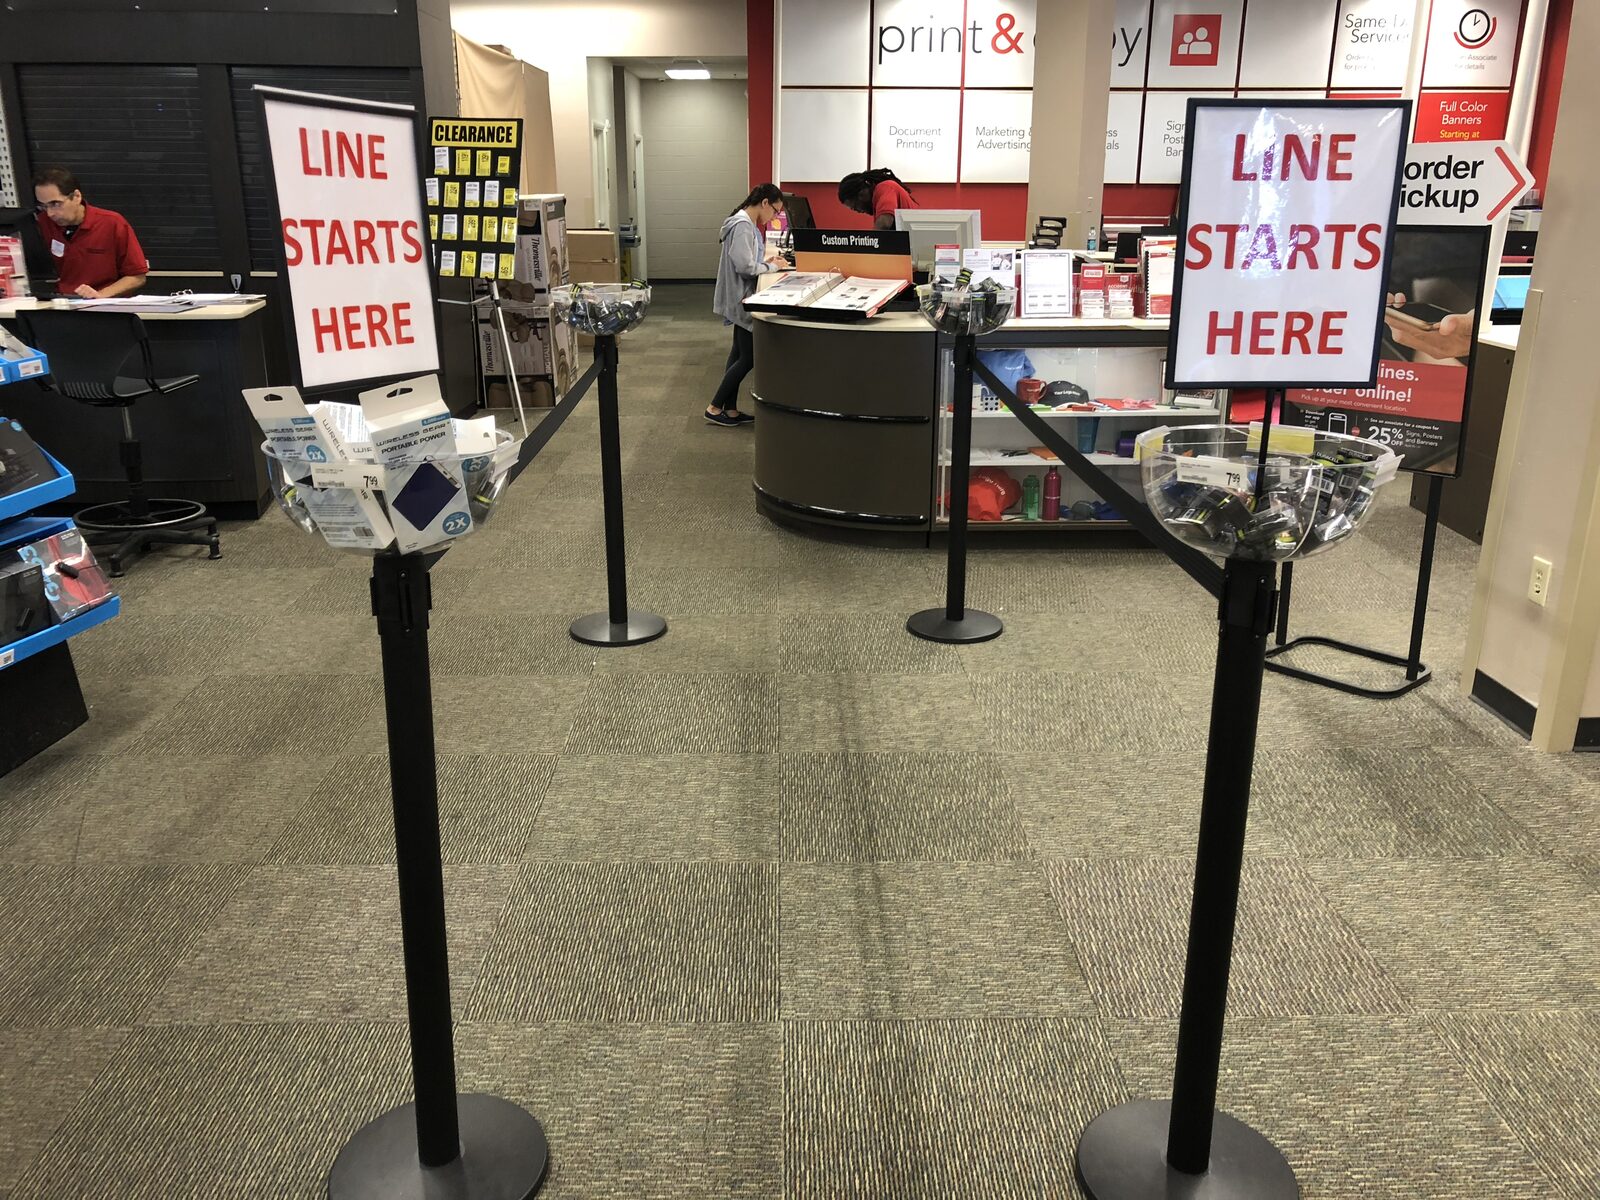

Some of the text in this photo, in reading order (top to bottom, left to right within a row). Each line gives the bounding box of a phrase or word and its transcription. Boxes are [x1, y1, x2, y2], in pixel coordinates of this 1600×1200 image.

[1345, 13, 1387, 28] Same
[878, 12, 1025, 65] print &
[1439, 101, 1488, 112] Full Color
[1441, 114, 1482, 126] Banners
[434, 124, 513, 144] CLEARANCE
[889, 125, 942, 136] Document
[975, 126, 1025, 139] Marketing
[1163, 133, 1185, 144] Post
[1439, 129, 1480, 140] Starting at
[298, 127, 388, 180] LINE
[896, 138, 934, 152] Printing
[976, 139, 1032, 152] Advertising
[1231, 133, 1357, 182] LINE
[1404, 155, 1484, 180] order
[1399, 183, 1479, 213] ickup
[281, 218, 423, 267] STARTS
[821, 234, 880, 248] Custom Printing
[1184, 223, 1382, 271] STARTS
[531, 237, 543, 283] Thomasville
[311, 302, 415, 354] HERE
[1206, 310, 1348, 355] HERE
[483, 330, 494, 374] Thomasville
[1355, 384, 1412, 402] online!
[1353, 401, 1383, 409] convenient
[1383, 404, 1408, 412] location.
[376, 423, 446, 447] WIRELESS GEAR
[381, 431, 446, 454] PORTABLE POWER
[1367, 425, 1404, 445] 25%
[1422, 432, 1443, 440] Posters
[1416, 438, 1438, 446] Banners
[308, 450, 325, 460] 2X
[1316, 451, 1339, 463] DURACELL
[445, 516, 467, 532] 2X
